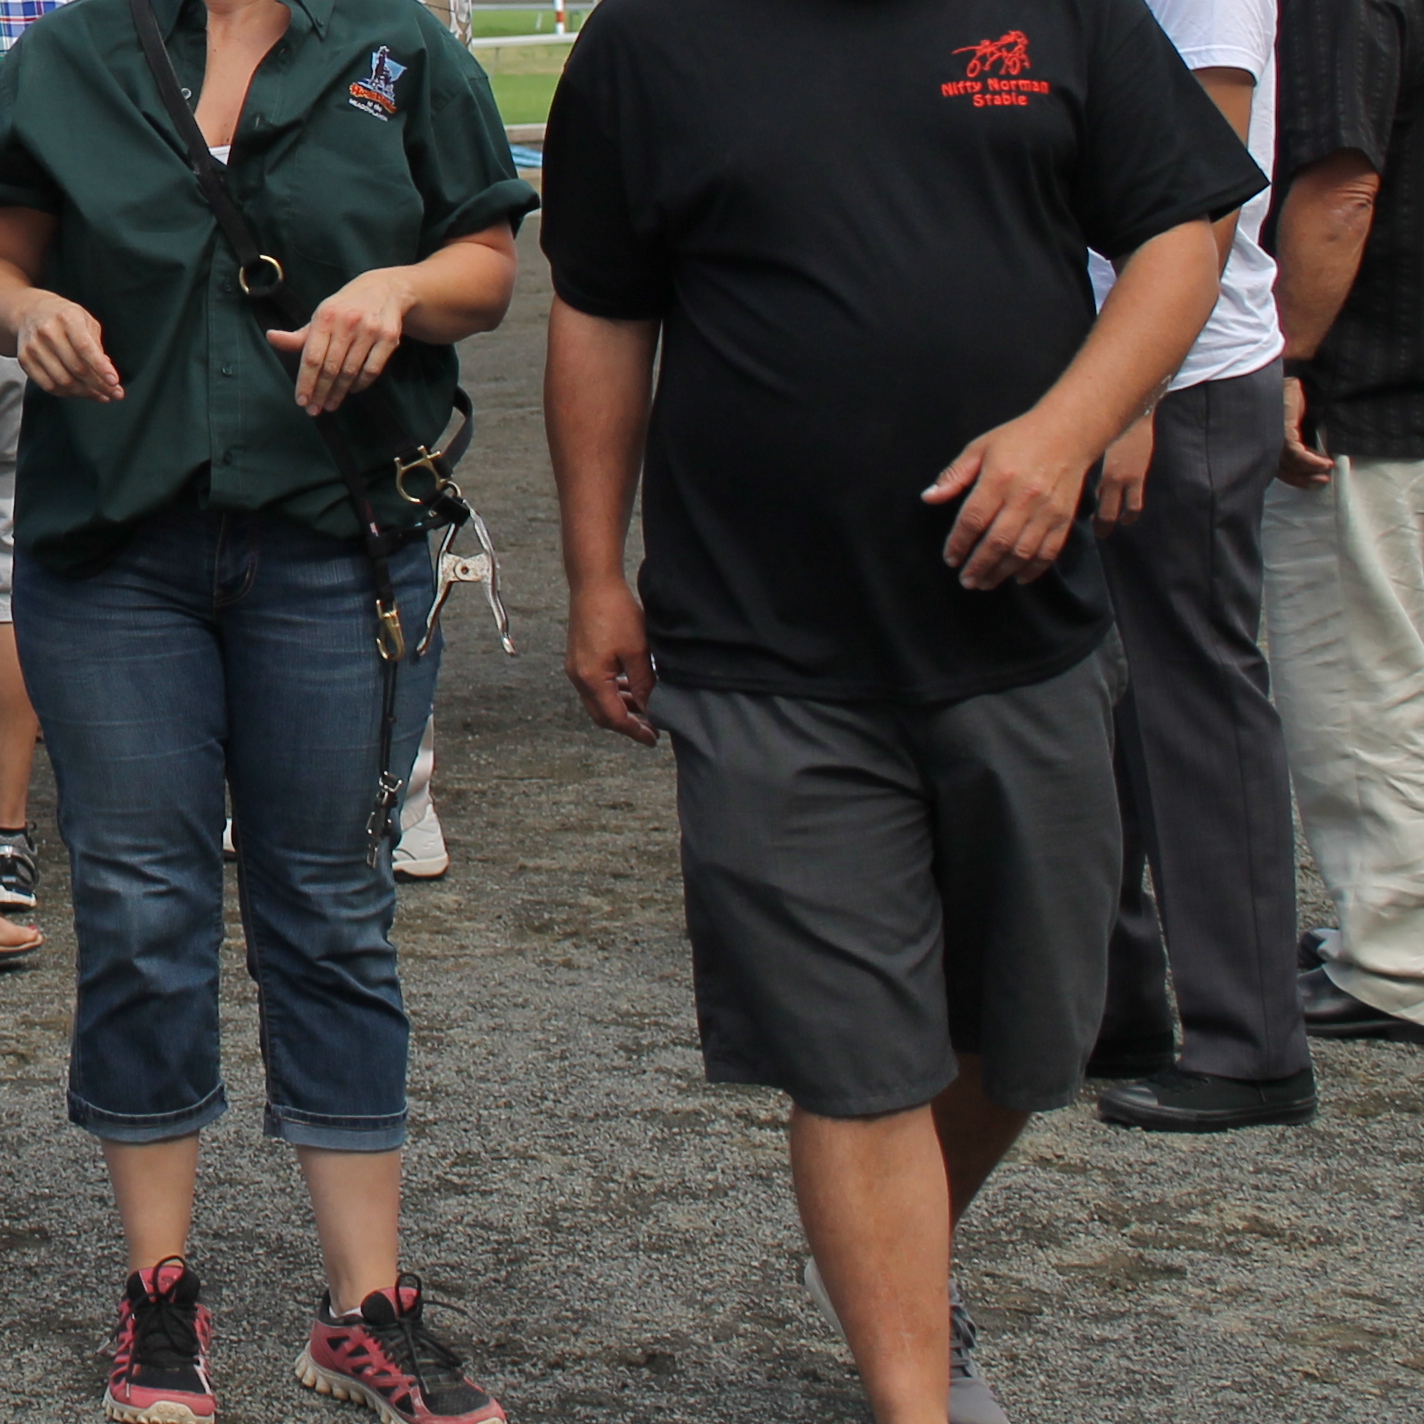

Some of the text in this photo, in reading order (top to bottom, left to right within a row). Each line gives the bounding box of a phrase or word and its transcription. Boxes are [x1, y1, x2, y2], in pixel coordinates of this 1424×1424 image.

[941, 78, 1051, 97] Nifty Norman
[972, 92, 1030, 108] Stable
